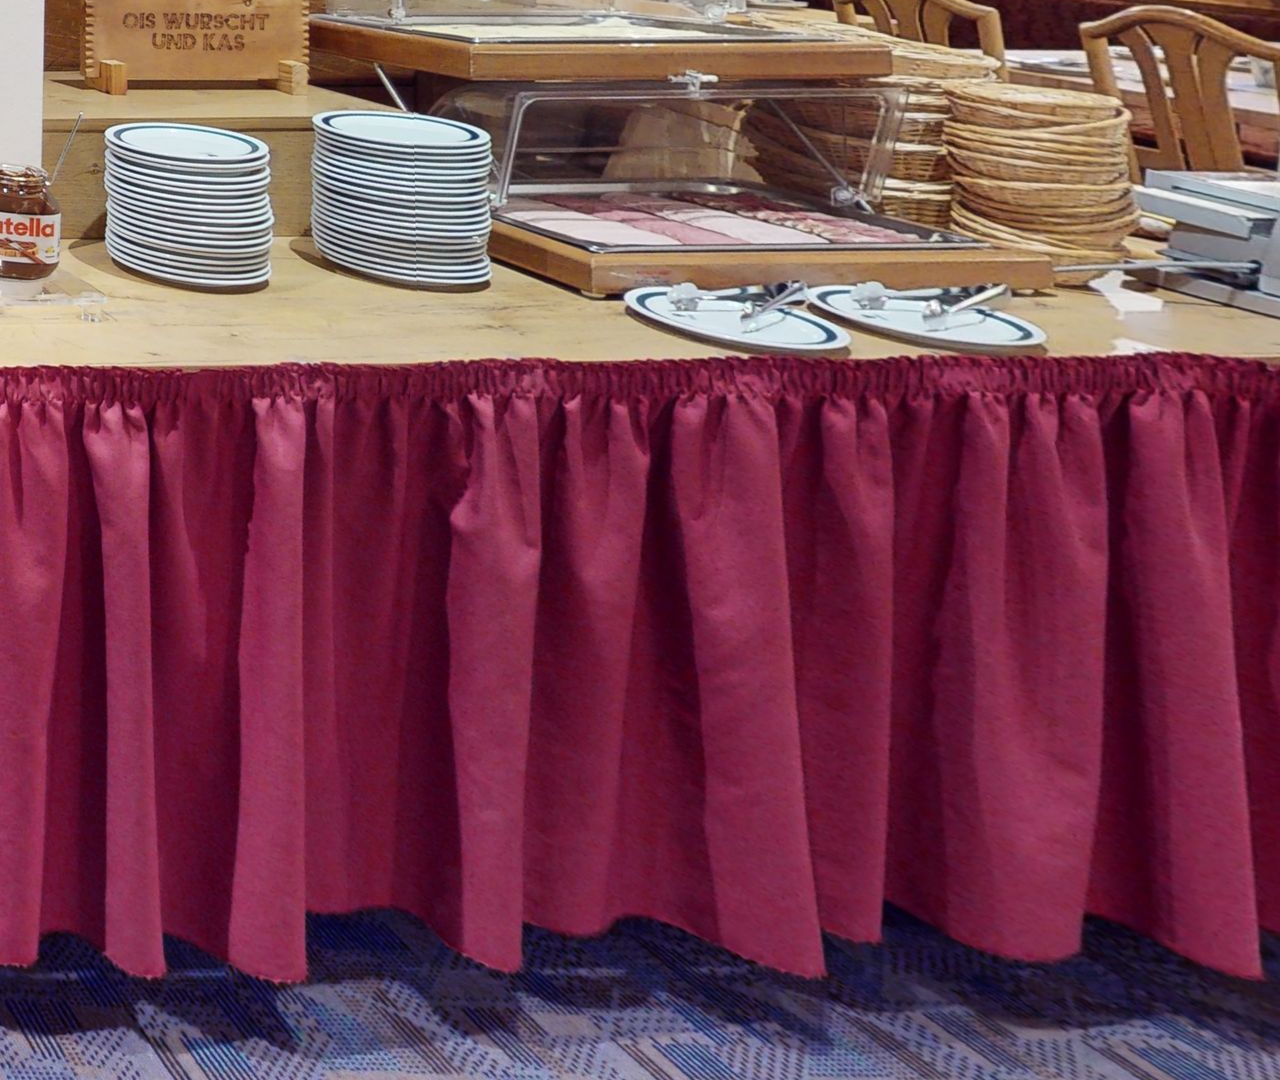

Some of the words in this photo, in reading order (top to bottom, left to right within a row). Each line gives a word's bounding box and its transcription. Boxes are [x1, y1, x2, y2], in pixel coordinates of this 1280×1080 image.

[122, 12, 156, 29] OIS
[162, 12, 269, 31] WURSCHT
[152, 33, 196, 50] UND
[203, 33, 245, 51] KAS
